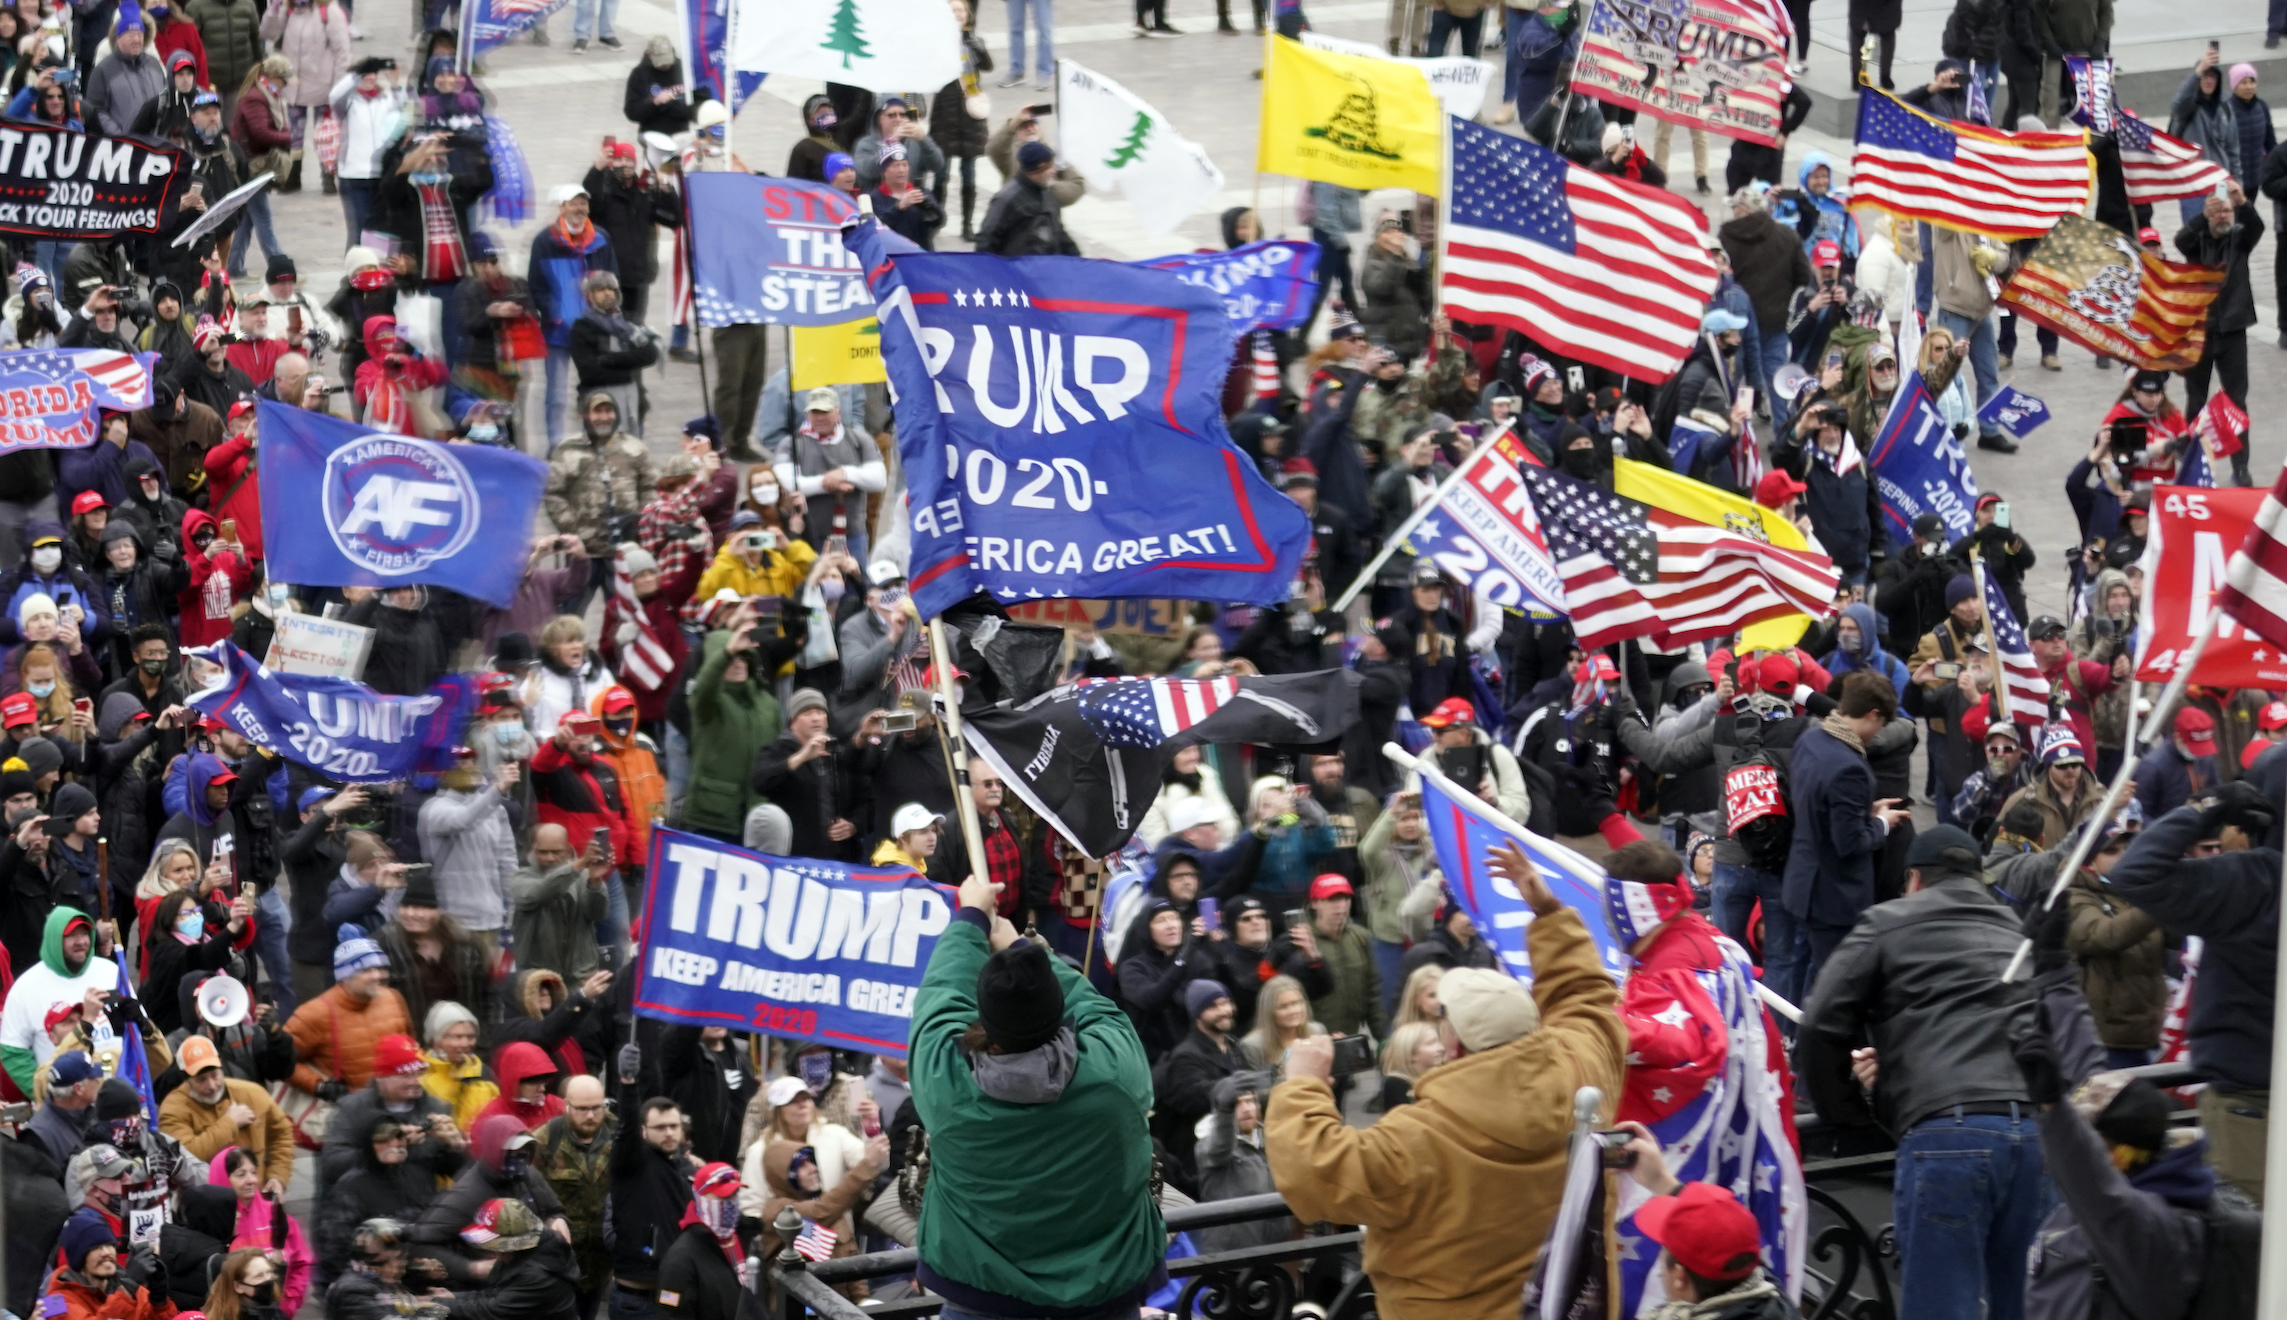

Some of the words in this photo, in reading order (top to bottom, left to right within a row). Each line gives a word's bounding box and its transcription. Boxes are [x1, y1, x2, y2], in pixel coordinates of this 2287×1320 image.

[1613, 0, 1766, 62] TRUMP
[2091, 60, 2111, 133] TRUMP
[0, 127, 171, 185] TRUMP
[46, 181, 94, 206] 2020
[763, 187, 862, 225] STO
[0, 202, 23, 223] CK
[25, 205, 77, 229] YOUR
[78, 208, 157, 230] FEELINGS
[761, 275, 875, 315] STEA
[0, 378, 93, 420] ORIDA
[915, 324, 1150, 434] RUMP
[0, 407, 96, 448] RUMP
[338, 474, 460, 541] AF
[1878, 477, 1922, 519] EEPING
[2164, 493, 2212, 520] 45
[965, 536, 1083, 576] ERICA
[1092, 523, 1239, 573] GREAT!
[1450, 486, 1499, 532] KEEP
[1494, 532, 1566, 606] AMERIC
[1004, 600, 1092, 624] EVER
[231, 702, 270, 748] KEEP
[1727, 787, 1780, 821] EAT
[668, 842, 951, 968] TRUMP
[652, 946, 718, 986] KEEP
[718, 960, 841, 1006] AMERICA
[846, 977, 918, 1018] GREA
[752, 1002, 818, 1035] 2020
